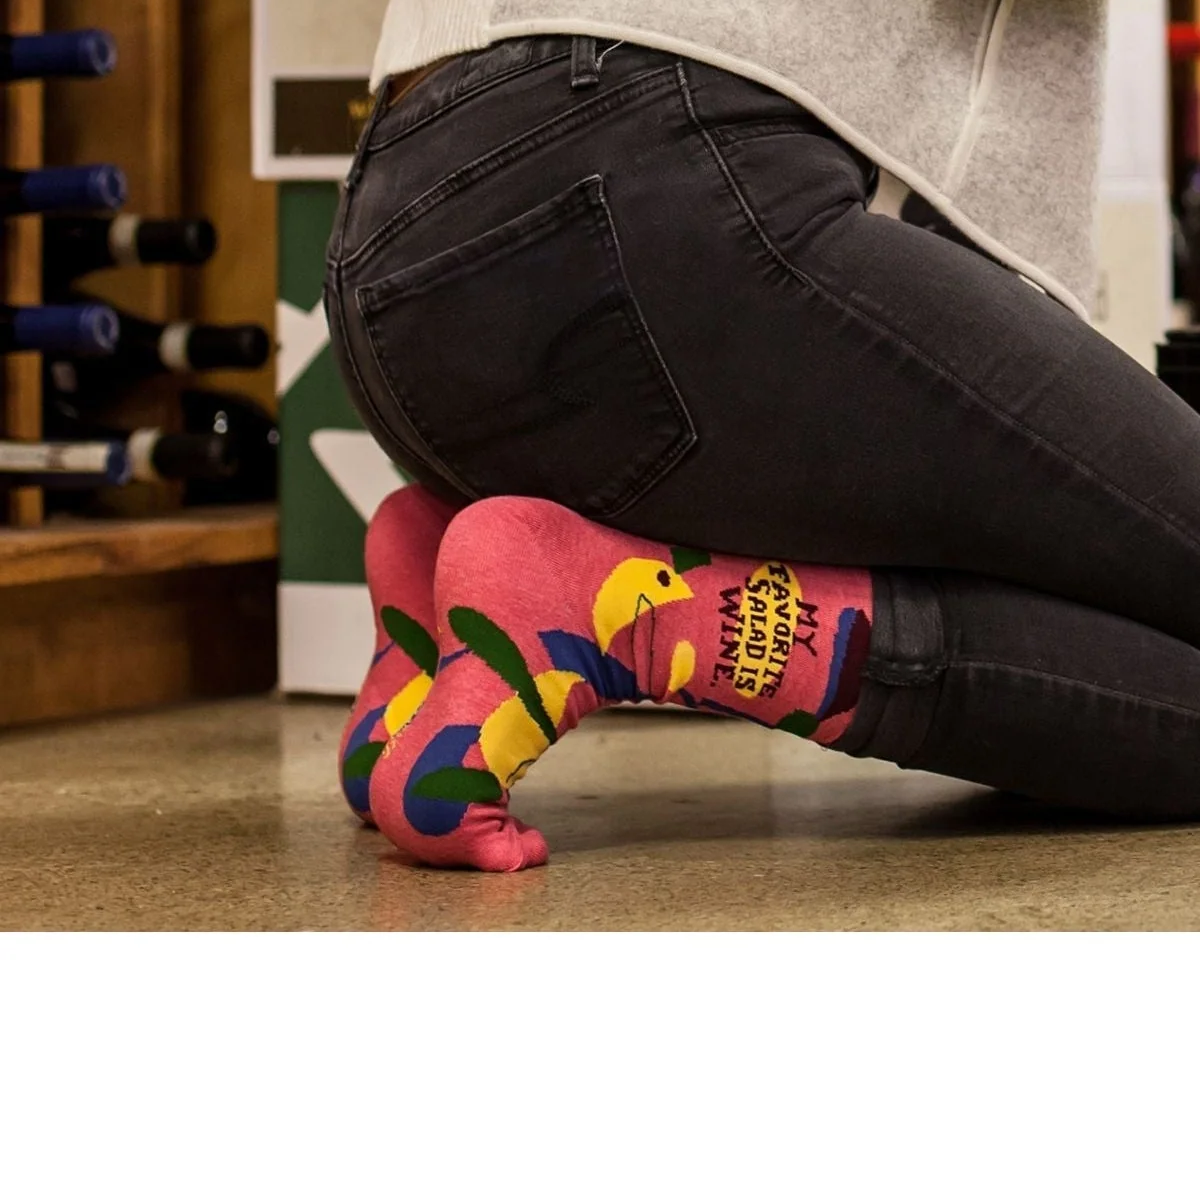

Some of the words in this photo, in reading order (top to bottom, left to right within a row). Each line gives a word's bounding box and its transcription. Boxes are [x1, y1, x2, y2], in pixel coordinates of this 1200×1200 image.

[710, 585, 745, 688] WINE.
[745, 576, 771, 661] SALAD
[758, 564, 791, 699] FAVORITE
[792, 597, 818, 657] MY
[735, 665, 759, 692] IS
